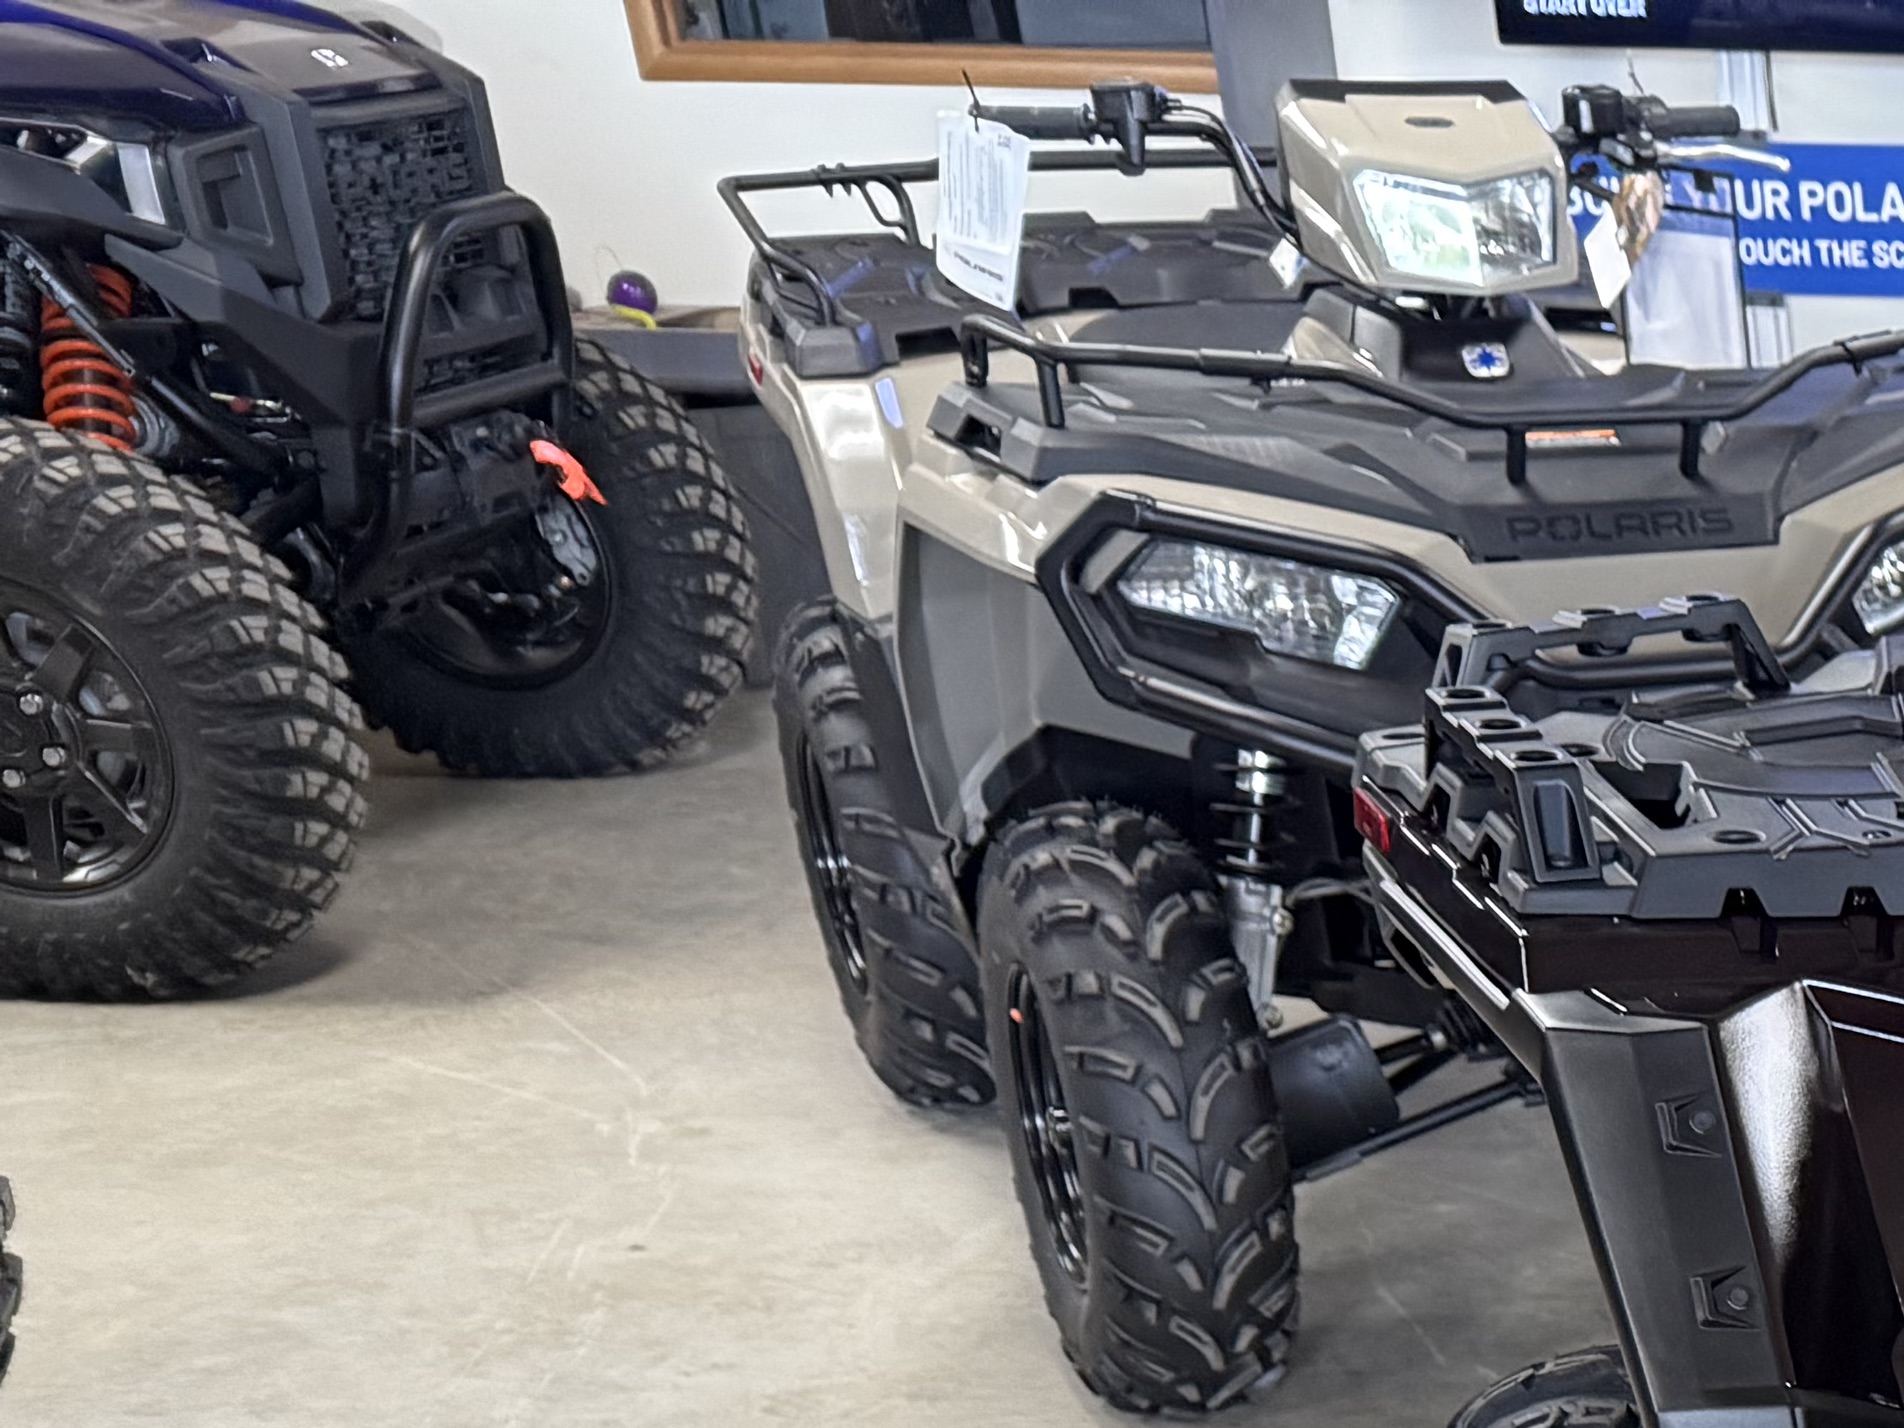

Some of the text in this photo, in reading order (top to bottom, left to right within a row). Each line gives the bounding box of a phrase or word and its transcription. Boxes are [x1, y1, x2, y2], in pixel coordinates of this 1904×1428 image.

[1738, 236, 1812, 268] OUCH
[1814, 238, 1869, 268] THE
[1505, 507, 1735, 543] POLARIS
